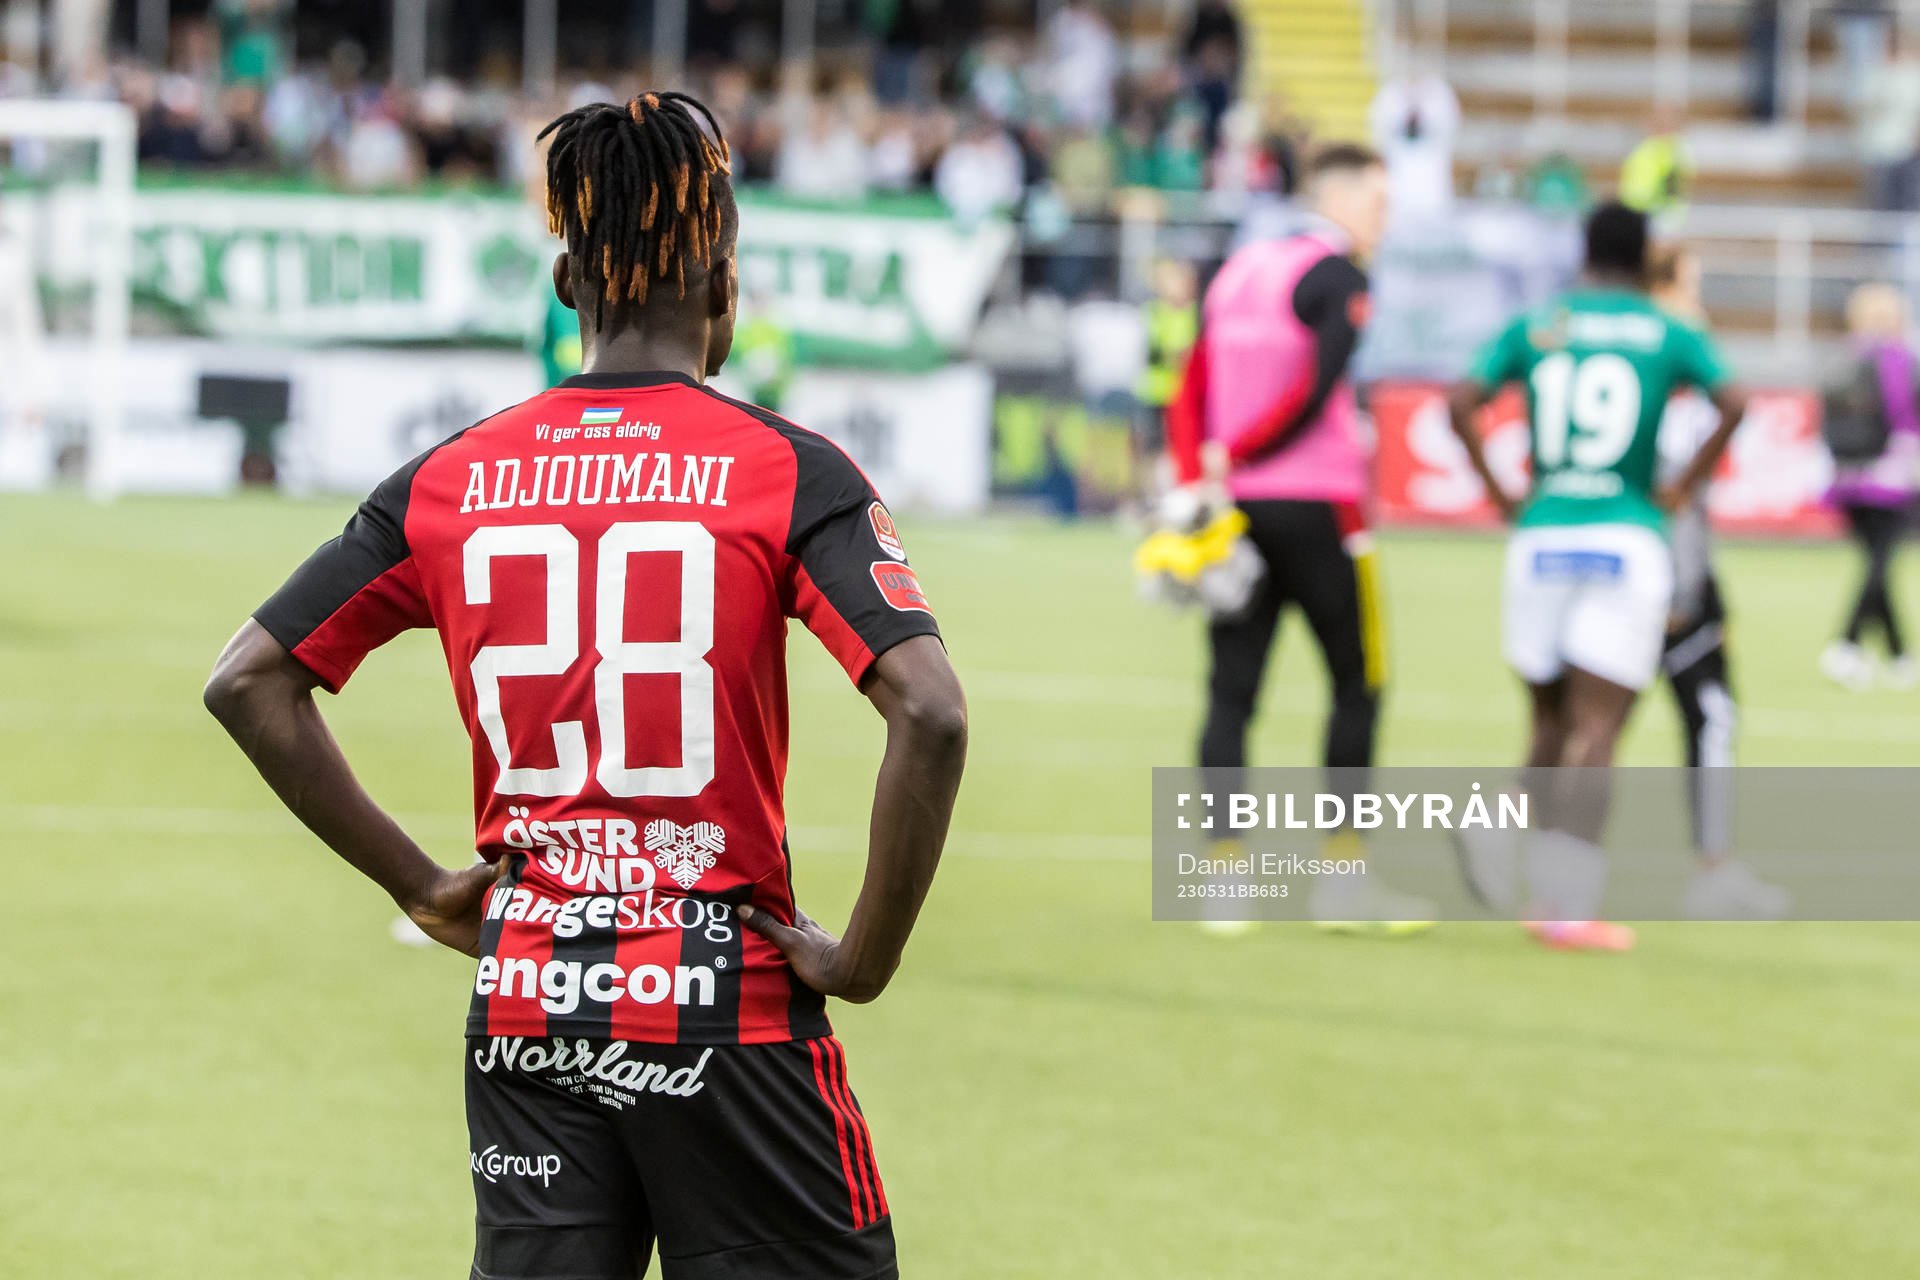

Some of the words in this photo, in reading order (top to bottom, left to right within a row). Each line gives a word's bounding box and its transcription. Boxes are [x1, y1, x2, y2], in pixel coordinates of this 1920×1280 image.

[535, 424, 550, 440] Vi
[552, 427, 580, 443] ger
[584, 426, 611, 439] oss
[615, 421, 661, 440] aldrig
[1530, 351, 1642, 469] 19
[460, 452, 734, 513] ADJOUMANI
[463, 521, 716, 797] 28
[503, 805, 639, 857] ÖSTER
[537, 844, 656, 893] SUND
[475, 955, 715, 1014] engcon
[474, 1036, 713, 1097] Norrland
